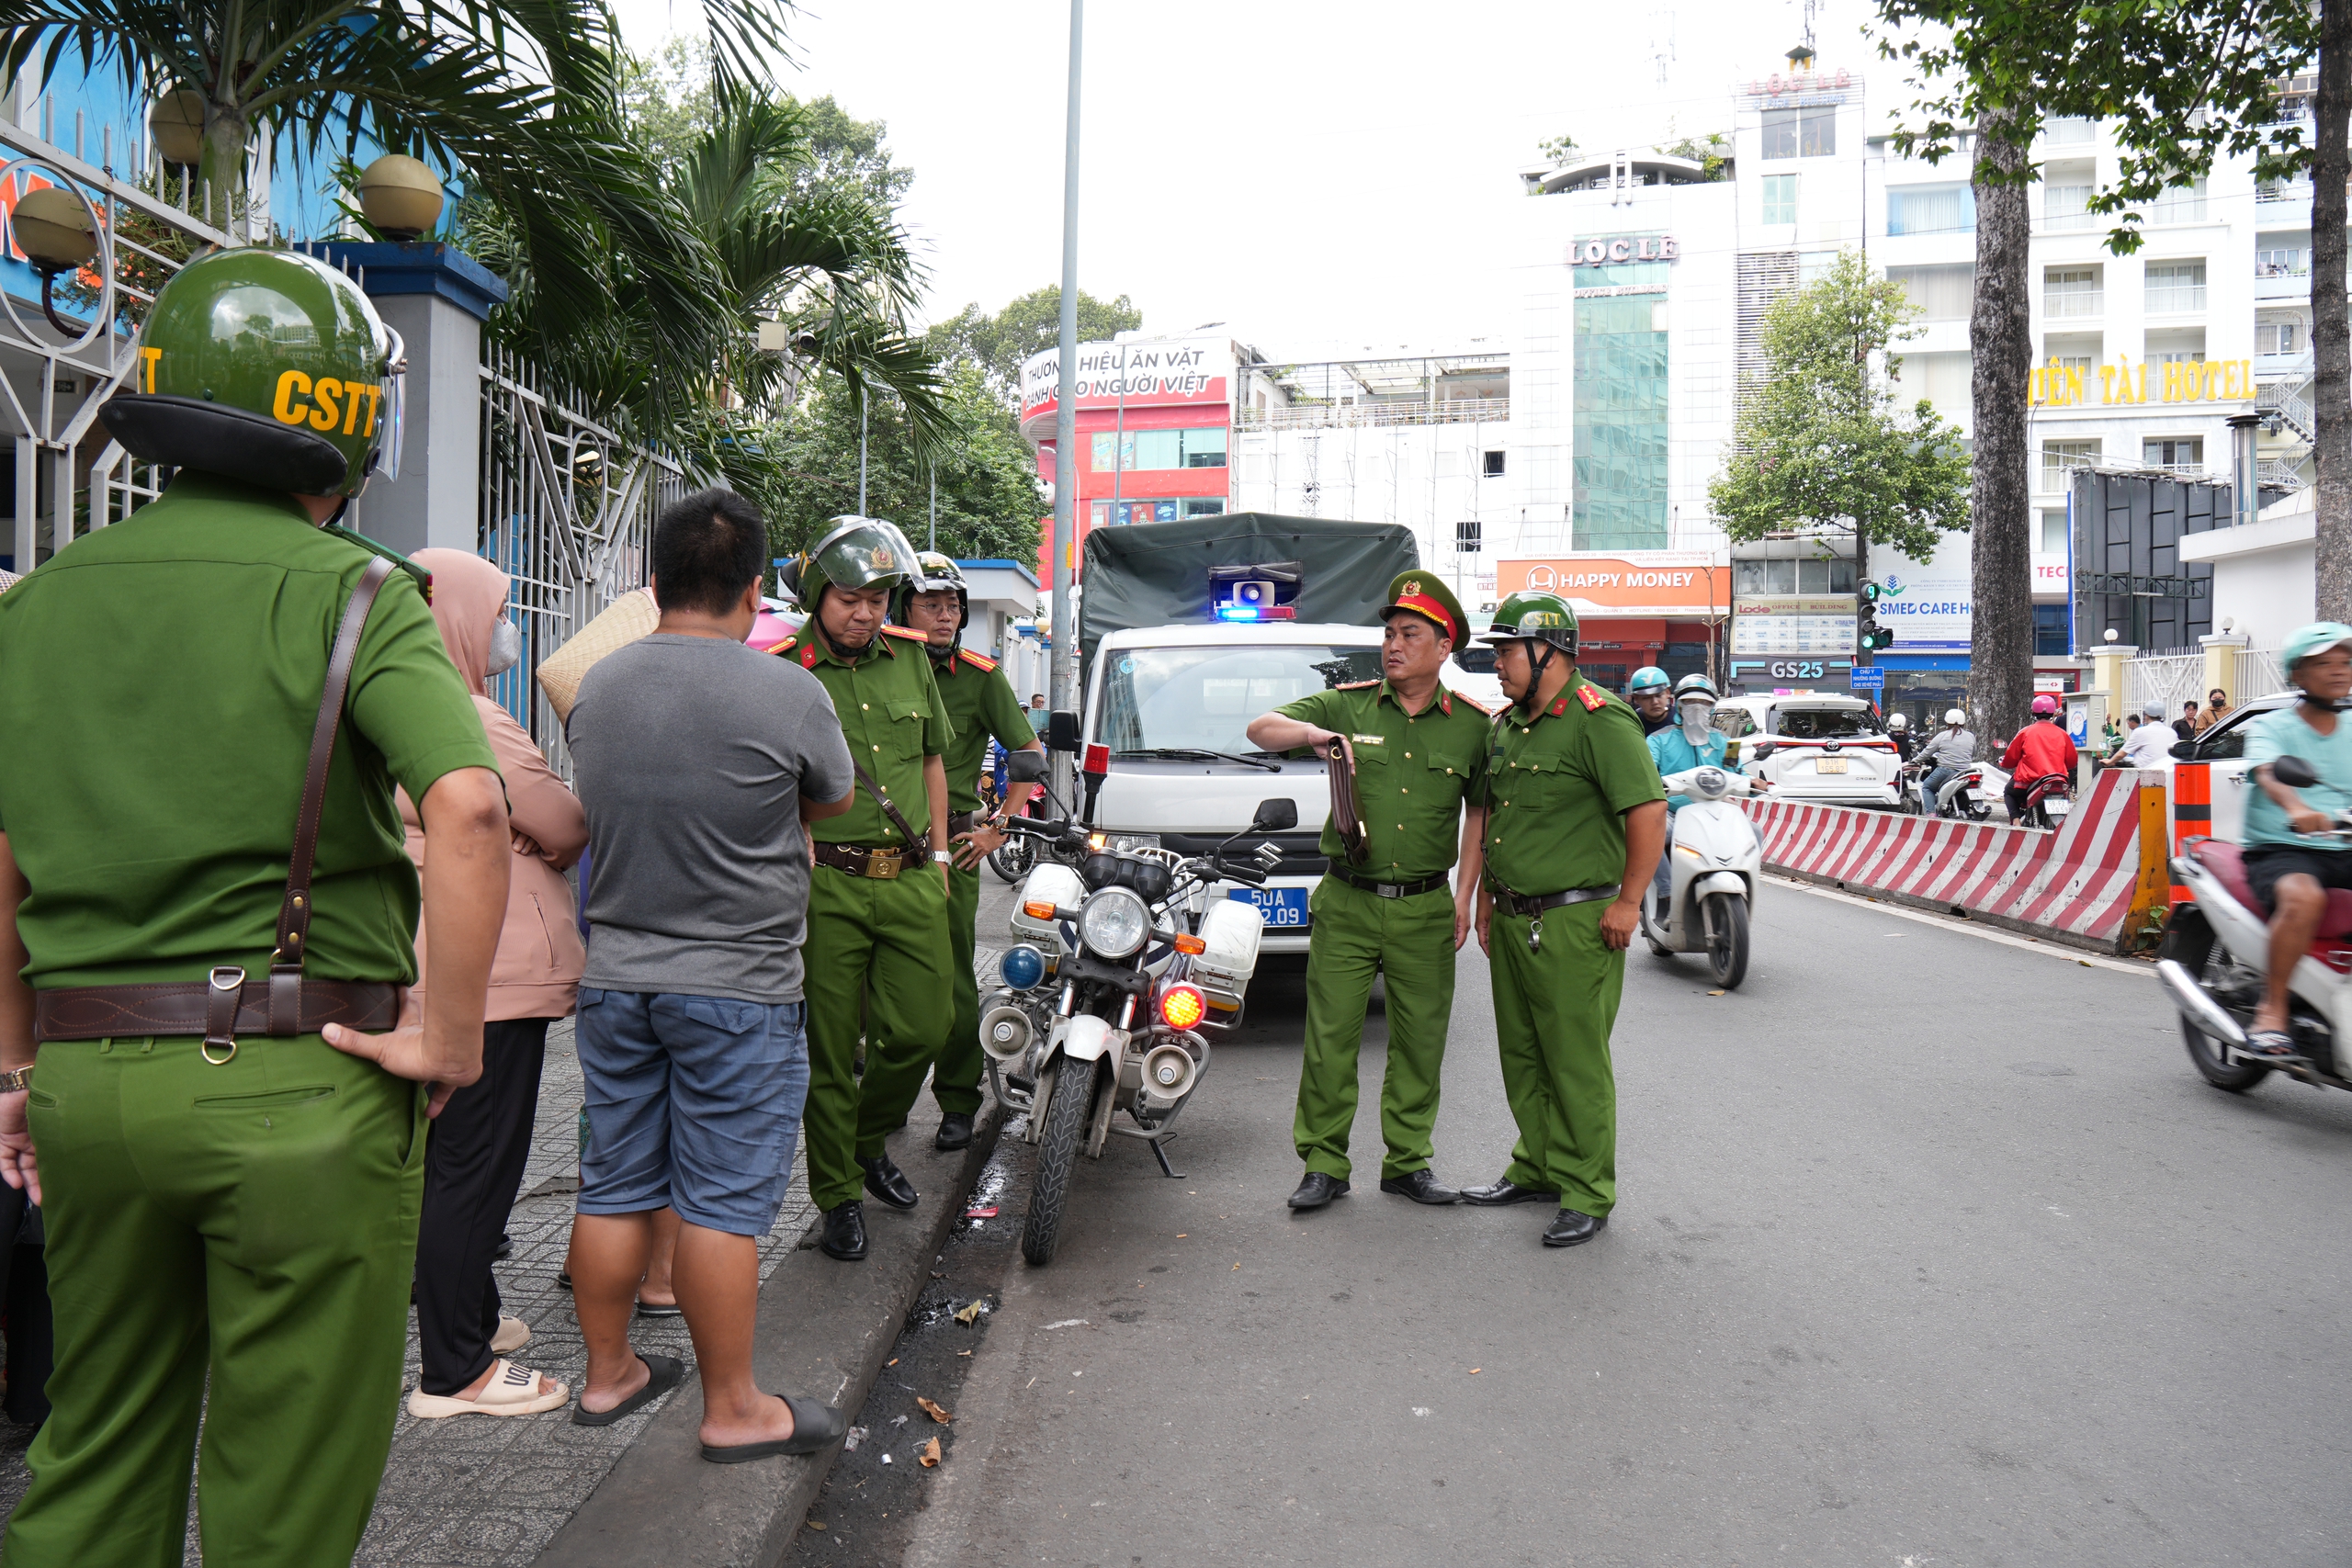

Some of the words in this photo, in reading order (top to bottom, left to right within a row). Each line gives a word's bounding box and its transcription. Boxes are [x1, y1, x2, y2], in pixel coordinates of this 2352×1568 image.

[1747, 73, 1804, 97] LỘC
[1566, 237, 1629, 268] LỘC
[1637, 234, 1679, 260] LÊ
[1573, 287, 1611, 299] OFFICE
[1616, 283, 1668, 296] BUILDING
[1028, 358, 1059, 384] THƯƠN
[1079, 350, 1123, 375] HIỆU
[1130, 348, 1159, 369] ĂN
[1166, 346, 1204, 371] VẶT
[1094, 372, 1159, 395] NGƯỜI
[1164, 370, 1210, 395] VIỆT
[2098, 353, 2148, 404] TÀI
[2162, 359, 2257, 402] HOTEL
[273, 369, 381, 437] CSTT
[1560, 573, 1622, 588] HAPPY
[1626, 572, 1694, 588] MONEY
[1868, 585, 1875, 600] 9
[1880, 603, 1917, 615] SMED
[1919, 603, 1957, 615] CARE
[1523, 613, 1561, 626] CSTT
[1770, 661, 1824, 679] GS25
[1251, 889, 1284, 907] 50A
[1261, 908, 1299, 924] 2.09
